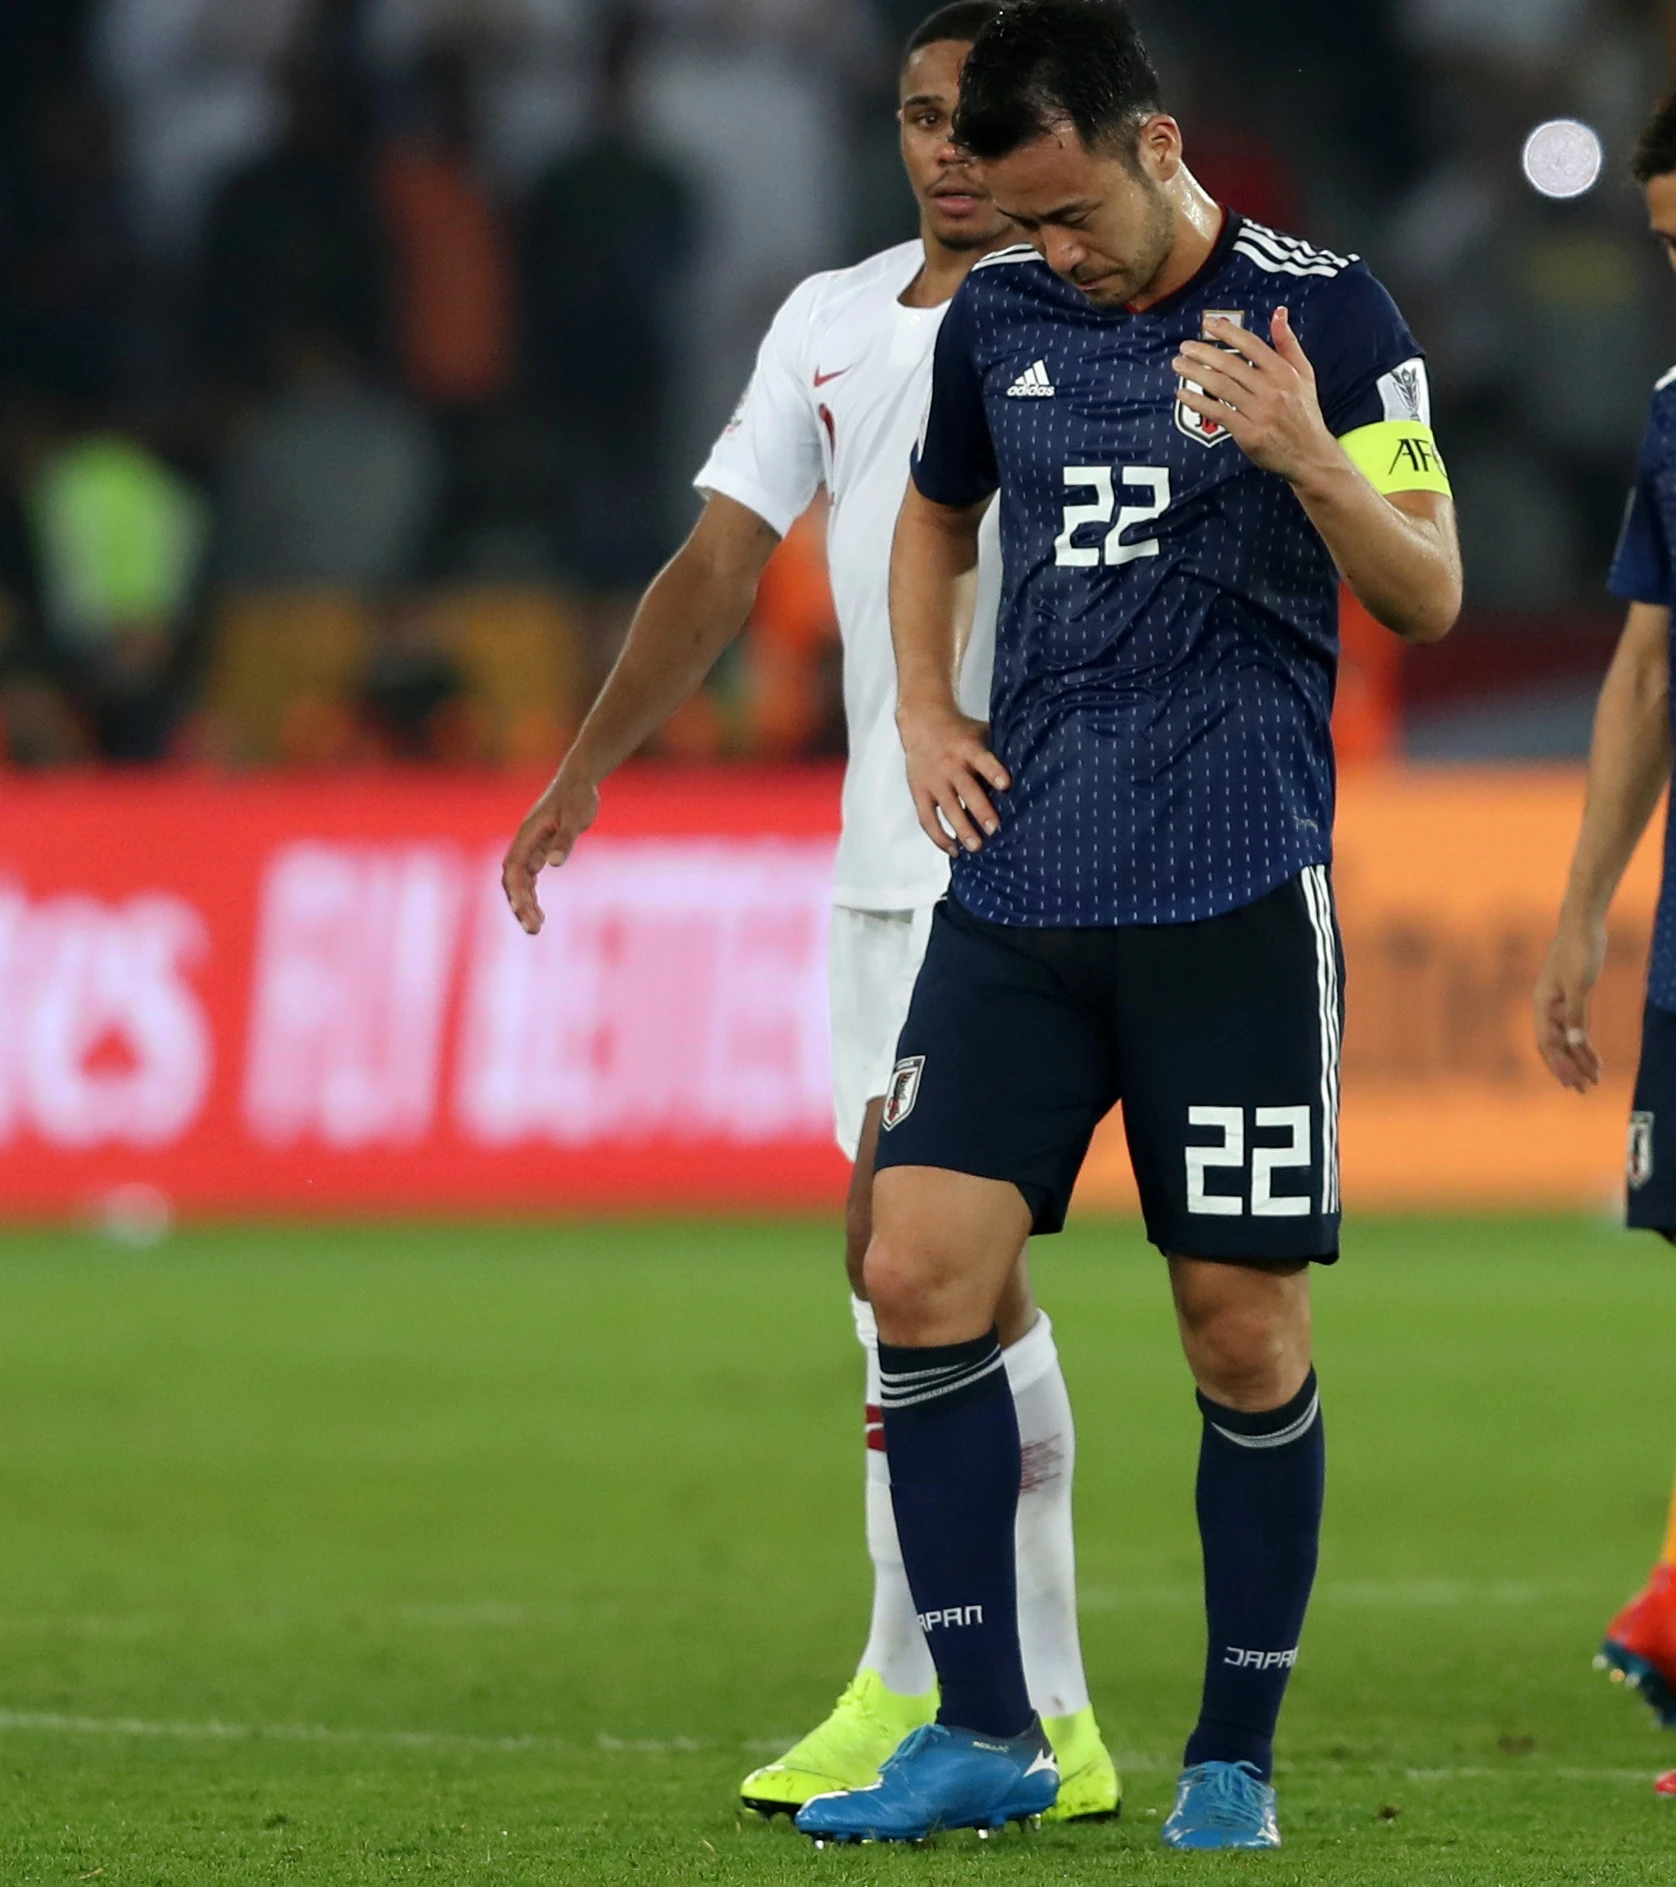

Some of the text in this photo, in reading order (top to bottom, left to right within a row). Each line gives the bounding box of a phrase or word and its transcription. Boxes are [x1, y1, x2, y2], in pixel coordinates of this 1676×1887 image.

[1007, 384, 1055, 397] adidas
[1054, 465, 1171, 567] 22
[1184, 1105, 1312, 1217] 22
[916, 1604, 984, 1633] APAN
